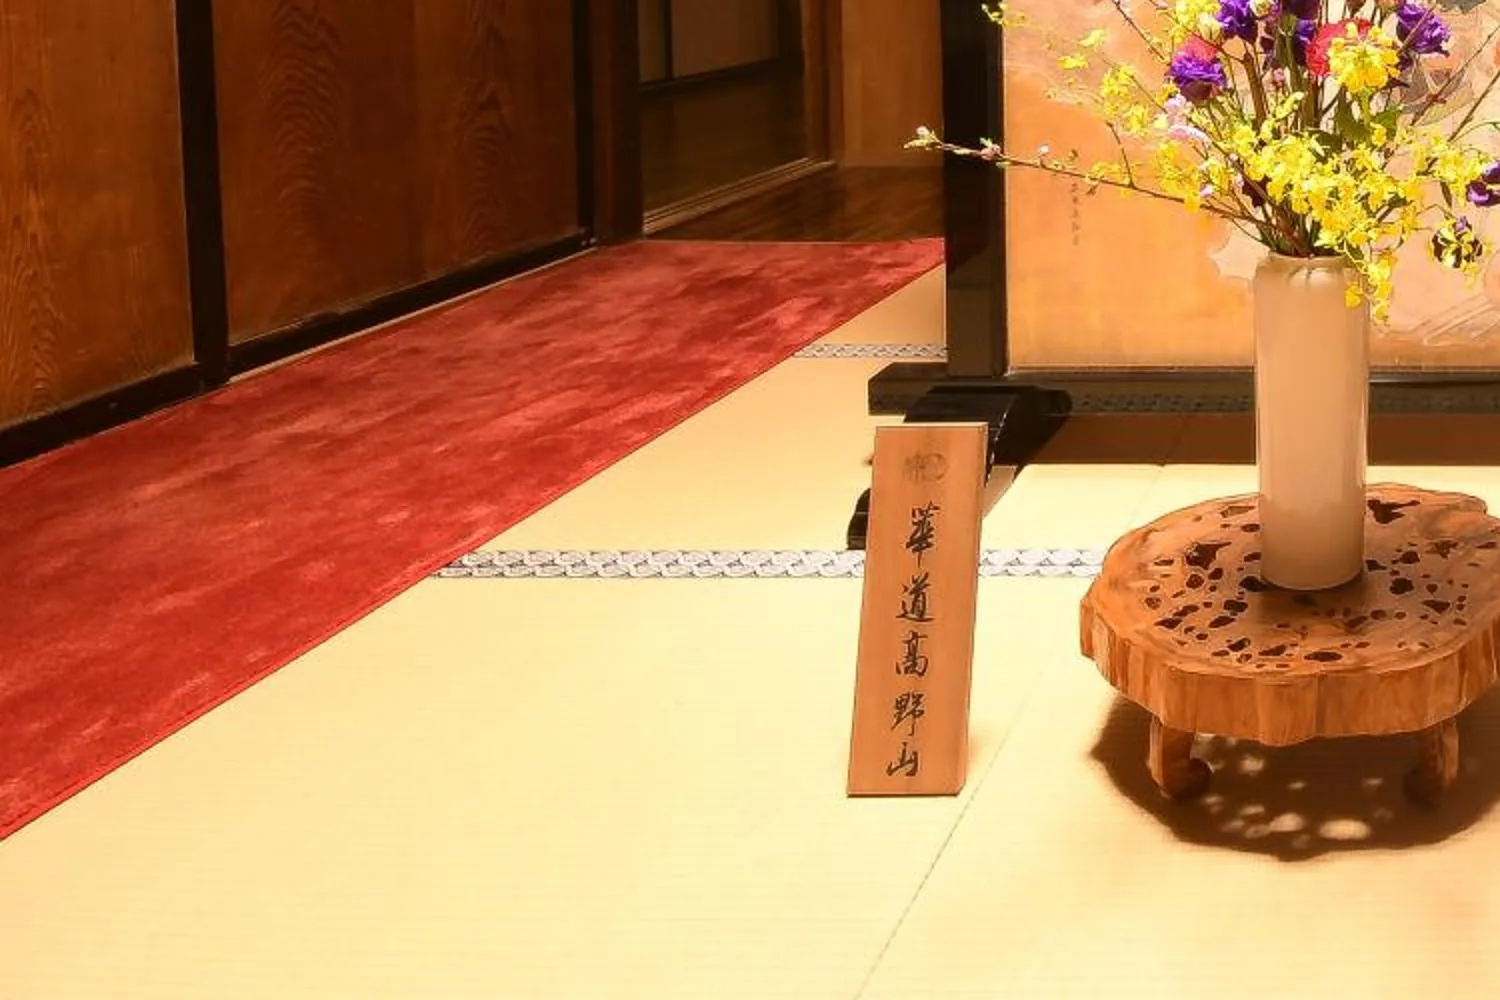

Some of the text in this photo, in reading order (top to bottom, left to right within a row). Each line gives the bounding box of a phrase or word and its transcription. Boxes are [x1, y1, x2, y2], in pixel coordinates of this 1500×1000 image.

[886, 500, 941, 778] 華道高野山
